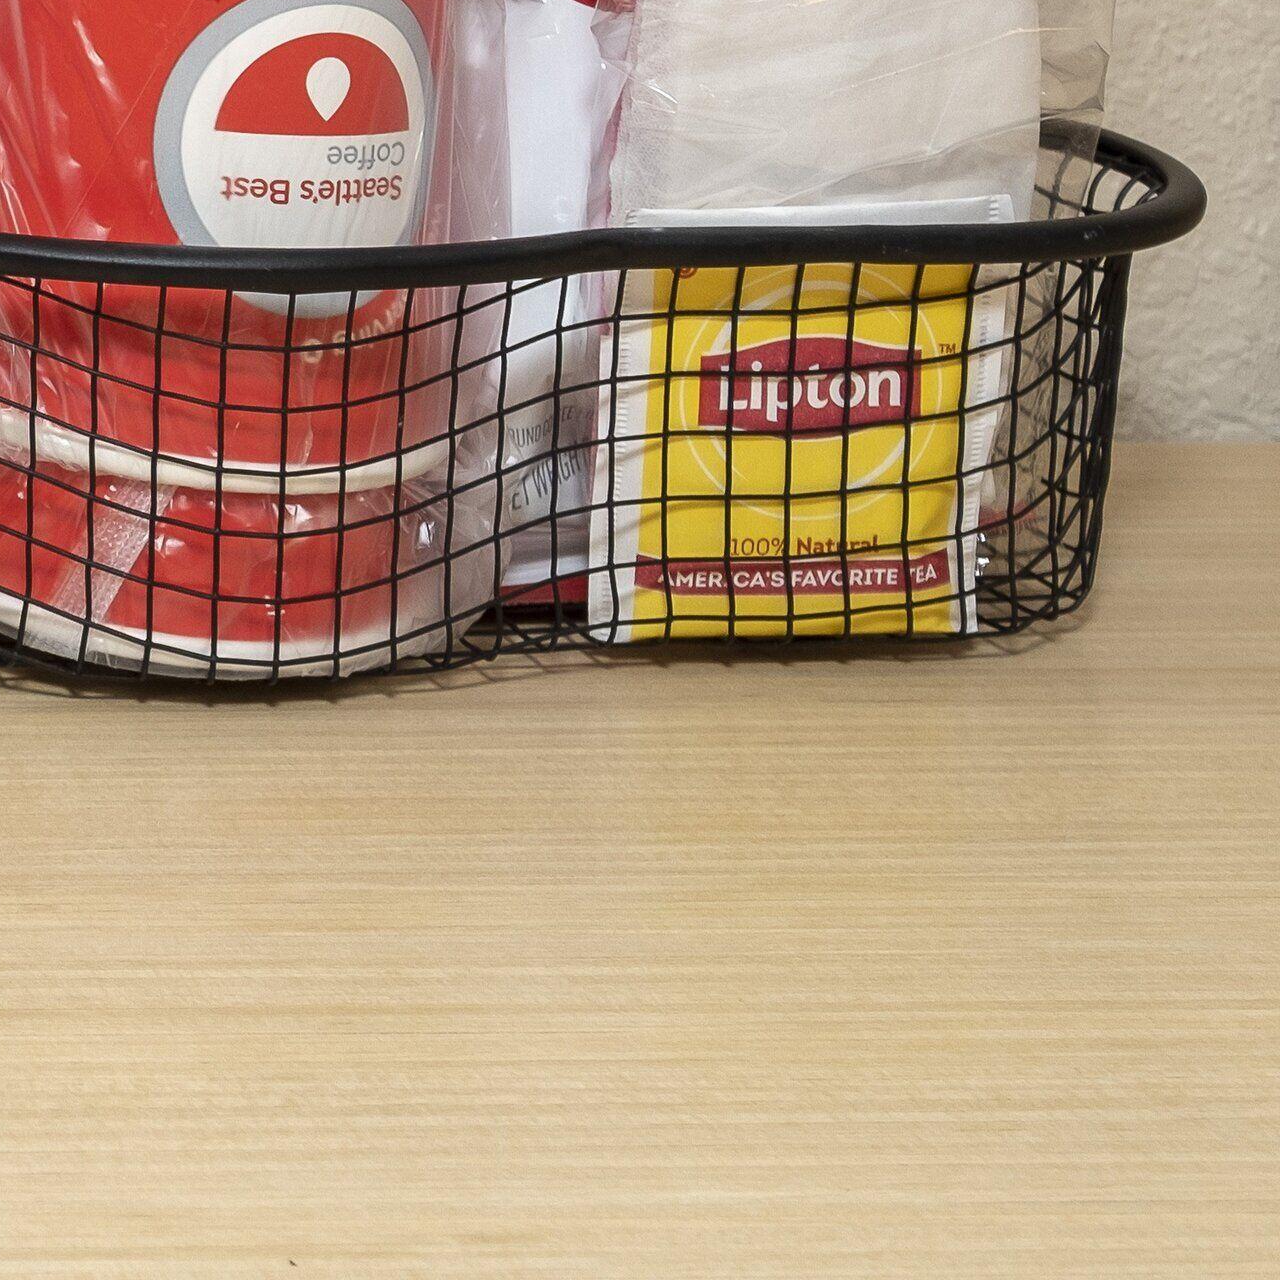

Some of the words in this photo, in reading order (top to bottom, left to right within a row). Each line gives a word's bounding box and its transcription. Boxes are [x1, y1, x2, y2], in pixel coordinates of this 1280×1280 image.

[326, 141, 406, 171] Coffee
[220, 175, 291, 206] Best
[299, 174, 404, 207] Seattle's
[719, 360, 902, 422] Lipton
[730, 537, 786, 557] 100%
[657, 570, 786, 588] AMERCA'S
